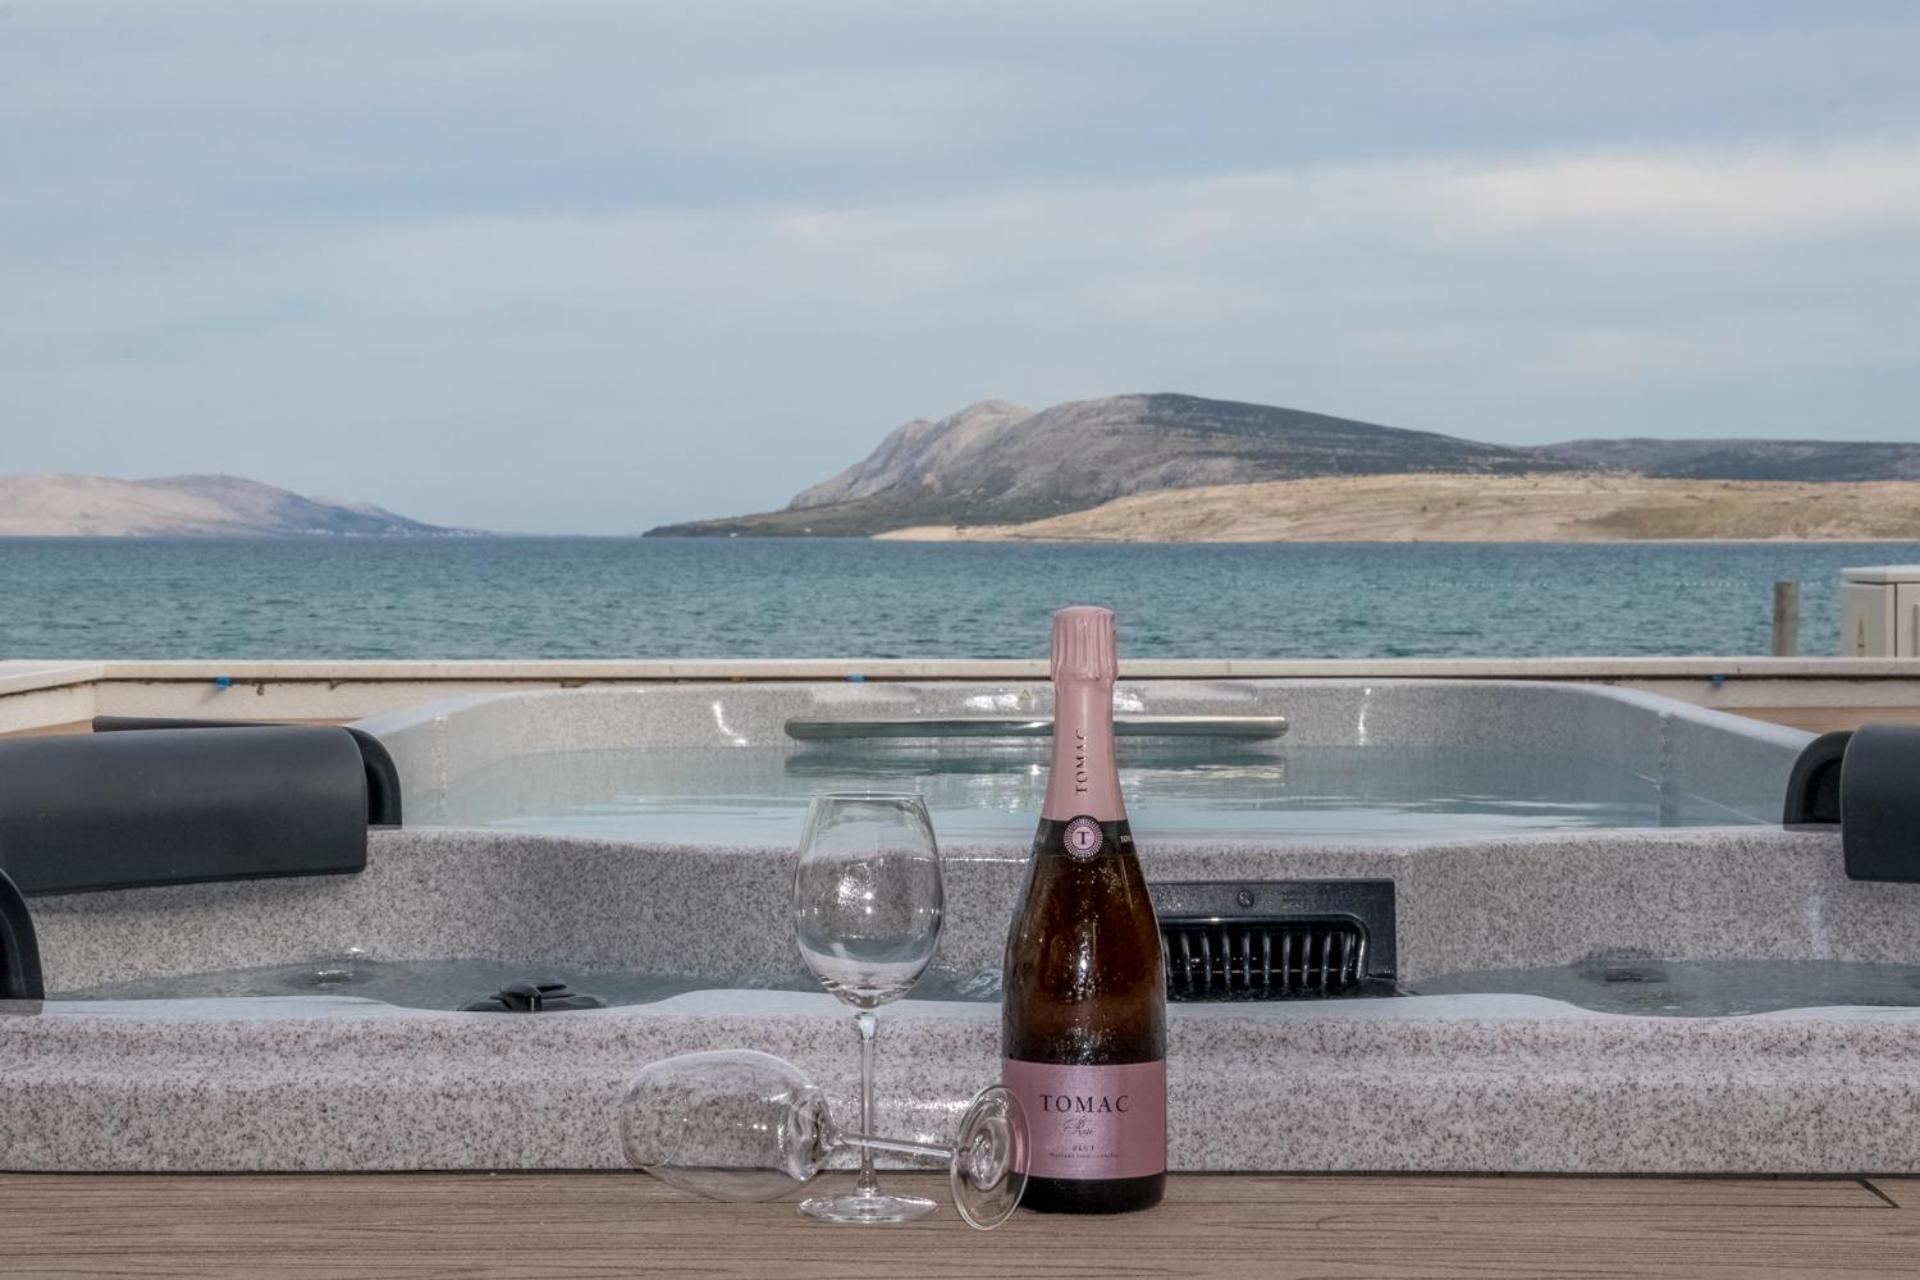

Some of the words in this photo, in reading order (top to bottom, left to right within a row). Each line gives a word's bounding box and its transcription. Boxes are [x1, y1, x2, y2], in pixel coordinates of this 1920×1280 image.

[1075, 728, 1088, 796] TOMAC
[1076, 831, 1090, 845] T
[1039, 1094, 1129, 1113] TOMAC
